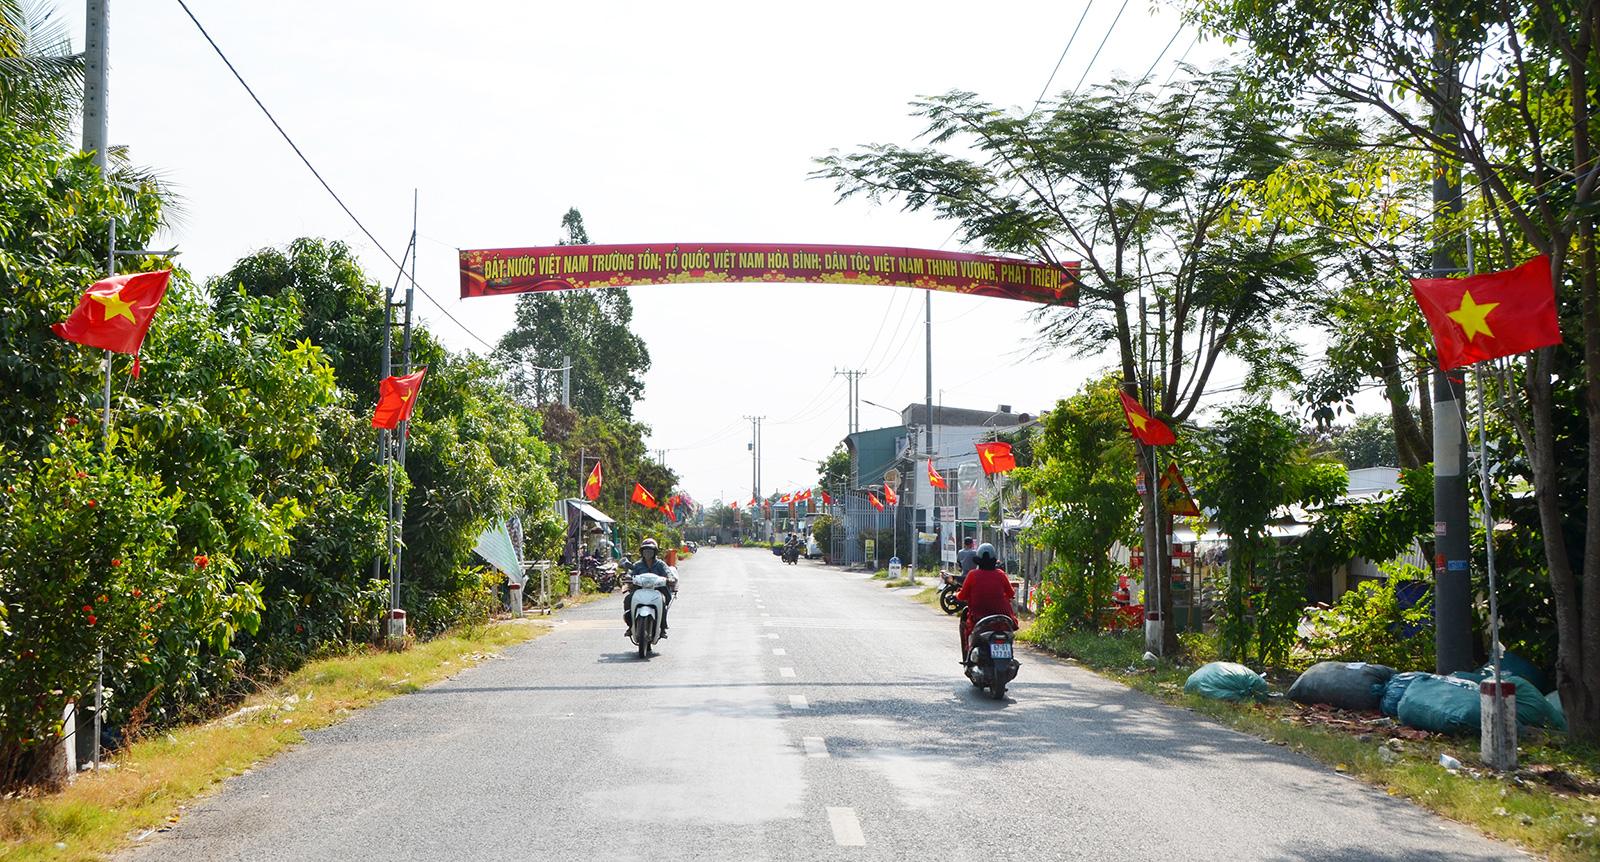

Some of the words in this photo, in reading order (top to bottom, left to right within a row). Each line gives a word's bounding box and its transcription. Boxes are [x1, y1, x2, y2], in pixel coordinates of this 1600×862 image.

[507, 254, 536, 277] NƯỚC
[539, 253, 561, 279] VIỆT
[563, 256, 589, 273] NAM
[592, 250, 634, 272] TRƯỜNG
[638, 248, 662, 271] TỒN;
[665, 246, 680, 270] TỔ
[681, 247, 710, 271] QUỐC
[713, 249, 736, 272] VIỆT
[739, 252, 764, 269] NAM
[767, 249, 789, 269] HÒA
[793, 249, 822, 271] BÌNH;
[825, 251, 848, 270] DÂN
[850, 252, 870, 274] TỘC
[873, 253, 896, 275] VIỆT
[899, 257, 924, 274] NAM
[926, 258, 958, 279] THỊNH
[960, 259, 999, 283] VƯỢNG,
[1001, 262, 1027, 284] PHÁT
[1030, 263, 1061, 288] TRIỂN!
